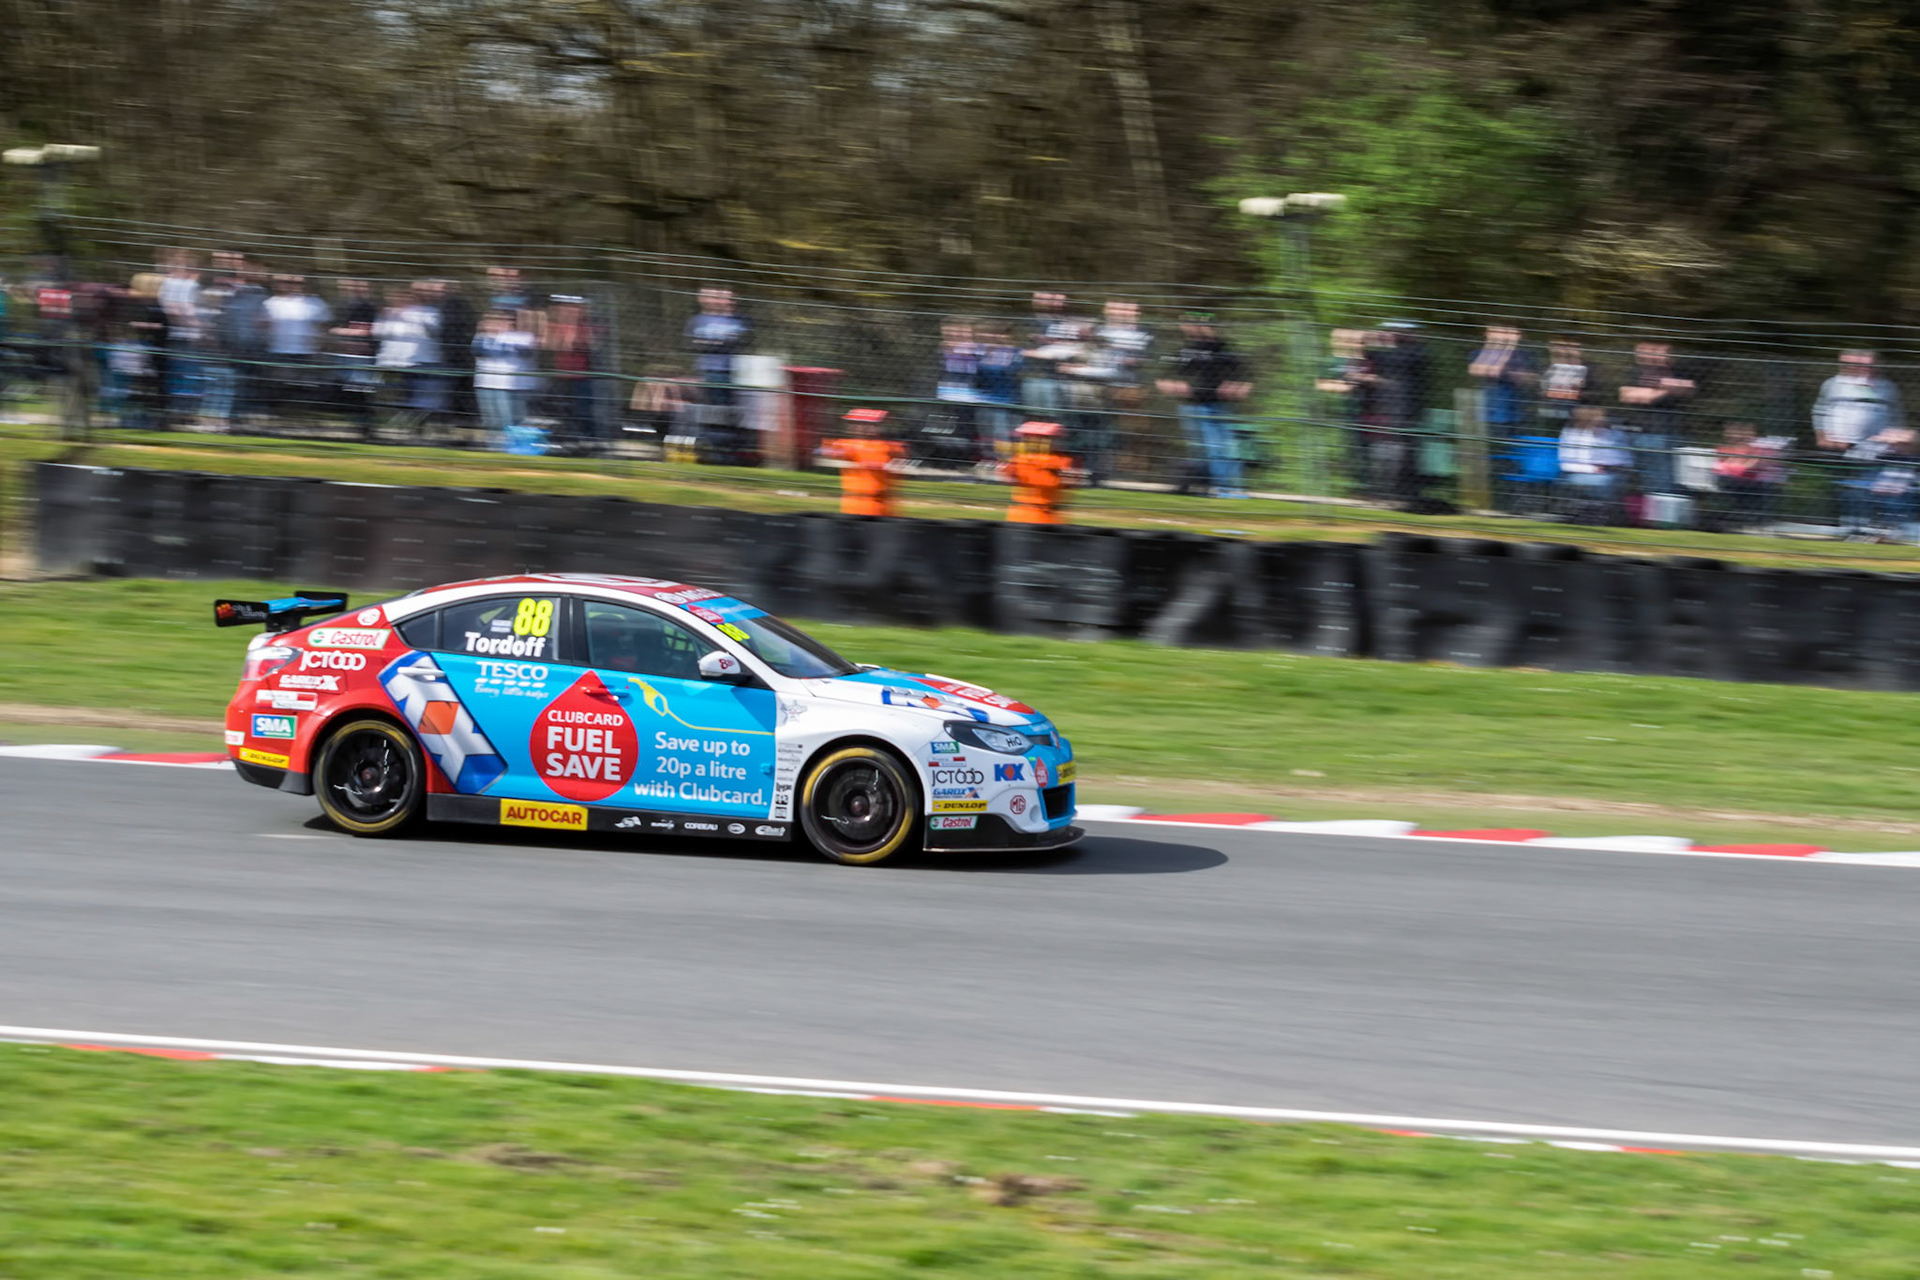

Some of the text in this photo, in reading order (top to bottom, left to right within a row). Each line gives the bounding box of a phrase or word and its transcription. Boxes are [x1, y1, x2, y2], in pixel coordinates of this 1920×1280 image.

[514, 598, 553, 636] 88
[330, 631, 380, 646] Castrol
[465, 631, 546, 657] Tordoff
[476, 661, 549, 681] TESCO
[256, 718, 291, 733] SMA
[548, 710, 624, 726] CLUBCARD
[547, 726, 621, 754] FUEL
[655, 731, 750, 757] Save up to
[933, 743, 956, 752] SMA
[546, 752, 621, 780] SAVE
[656, 756, 747, 780] 20p a litre
[634, 780, 675, 798] with
[680, 782, 767, 806] Clubcard.
[506, 806, 582, 825] AUTOCAR
[942, 817, 973, 828] Castrol
